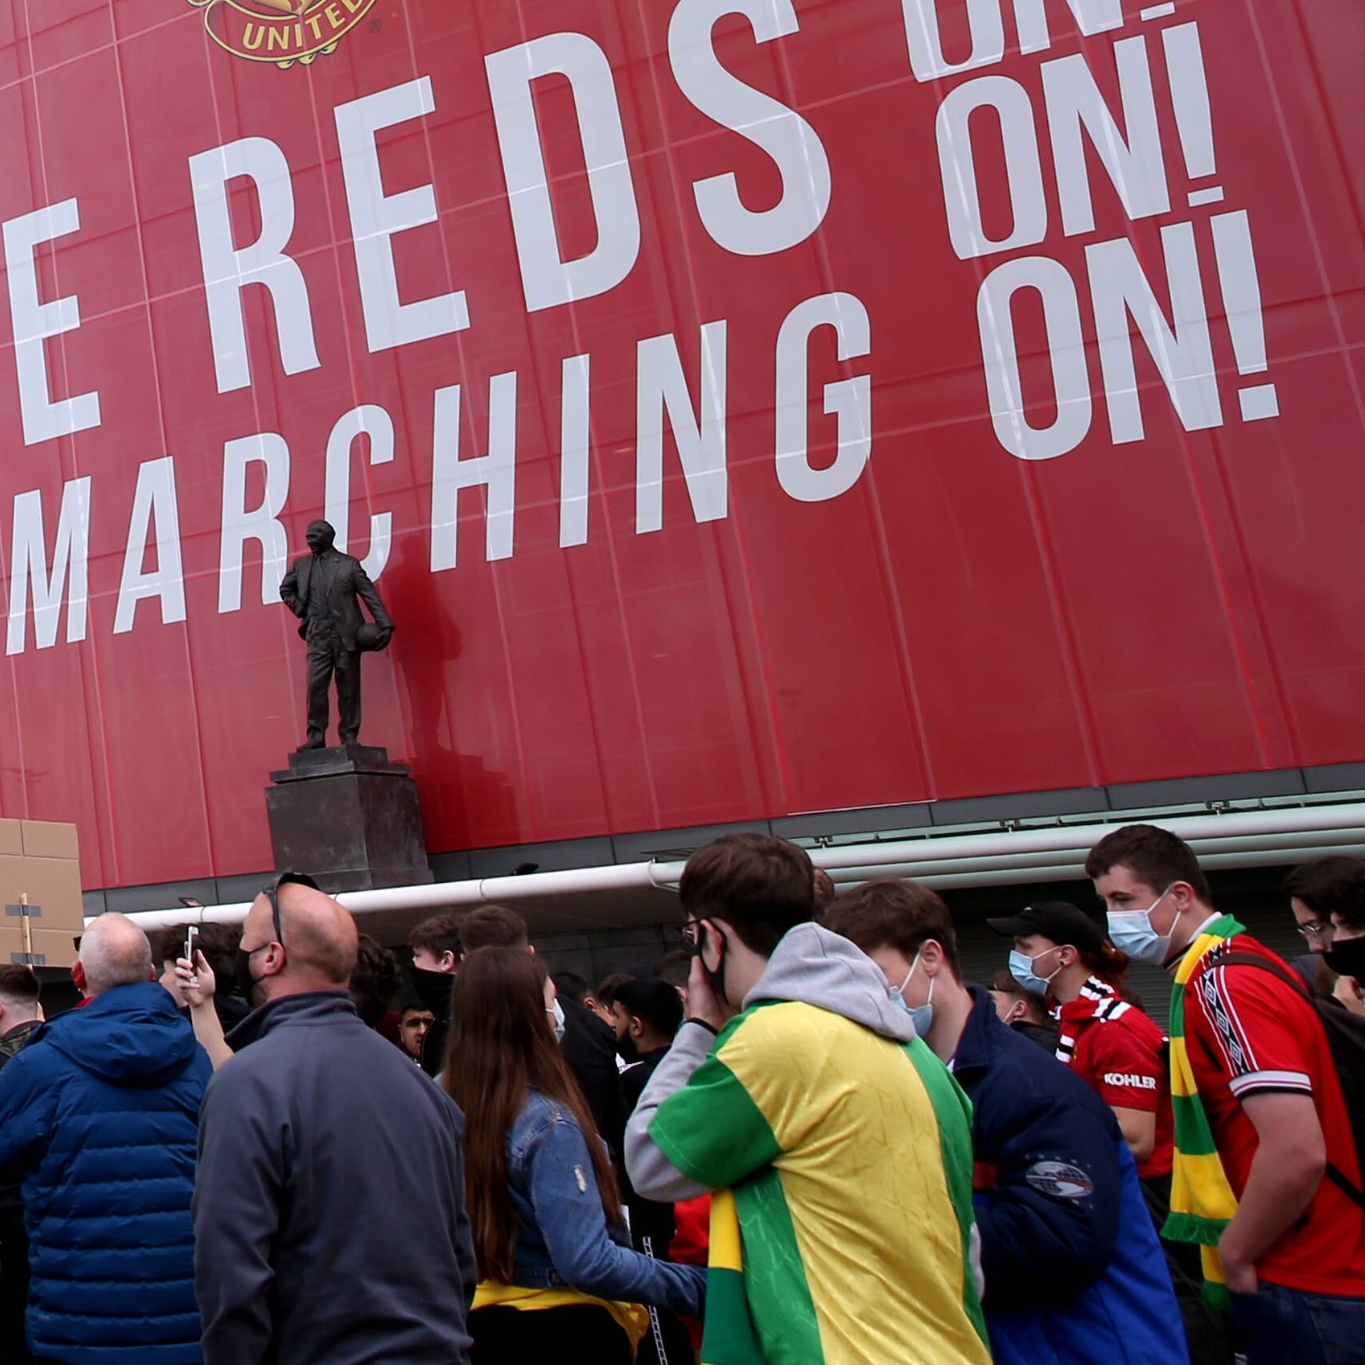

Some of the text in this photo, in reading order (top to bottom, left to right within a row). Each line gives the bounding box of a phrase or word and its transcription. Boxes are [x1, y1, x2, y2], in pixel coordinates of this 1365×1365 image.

[935, 20, 1225, 260] ON!
[976, 209, 1280, 461] ON!
[6, 290, 872, 658] MARCHING
[1104, 1072, 1157, 1090] KOHLER
